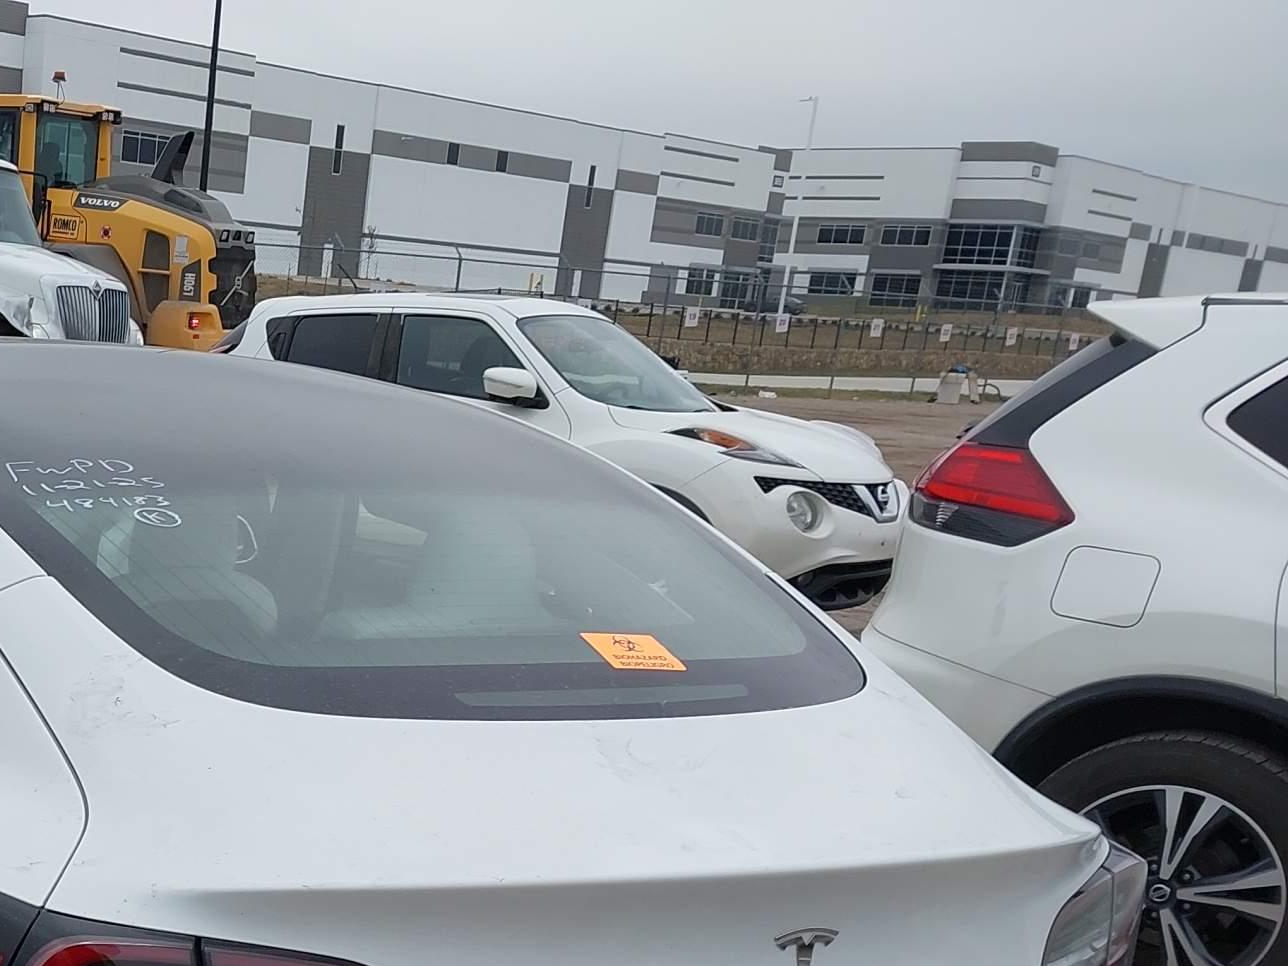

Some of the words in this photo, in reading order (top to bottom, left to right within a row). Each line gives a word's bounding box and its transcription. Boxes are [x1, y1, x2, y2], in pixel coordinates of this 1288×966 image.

[80, 197, 120, 208] VOLVO
[53, 217, 77, 231] ROMCO
[183, 272, 196, 296] L90H
